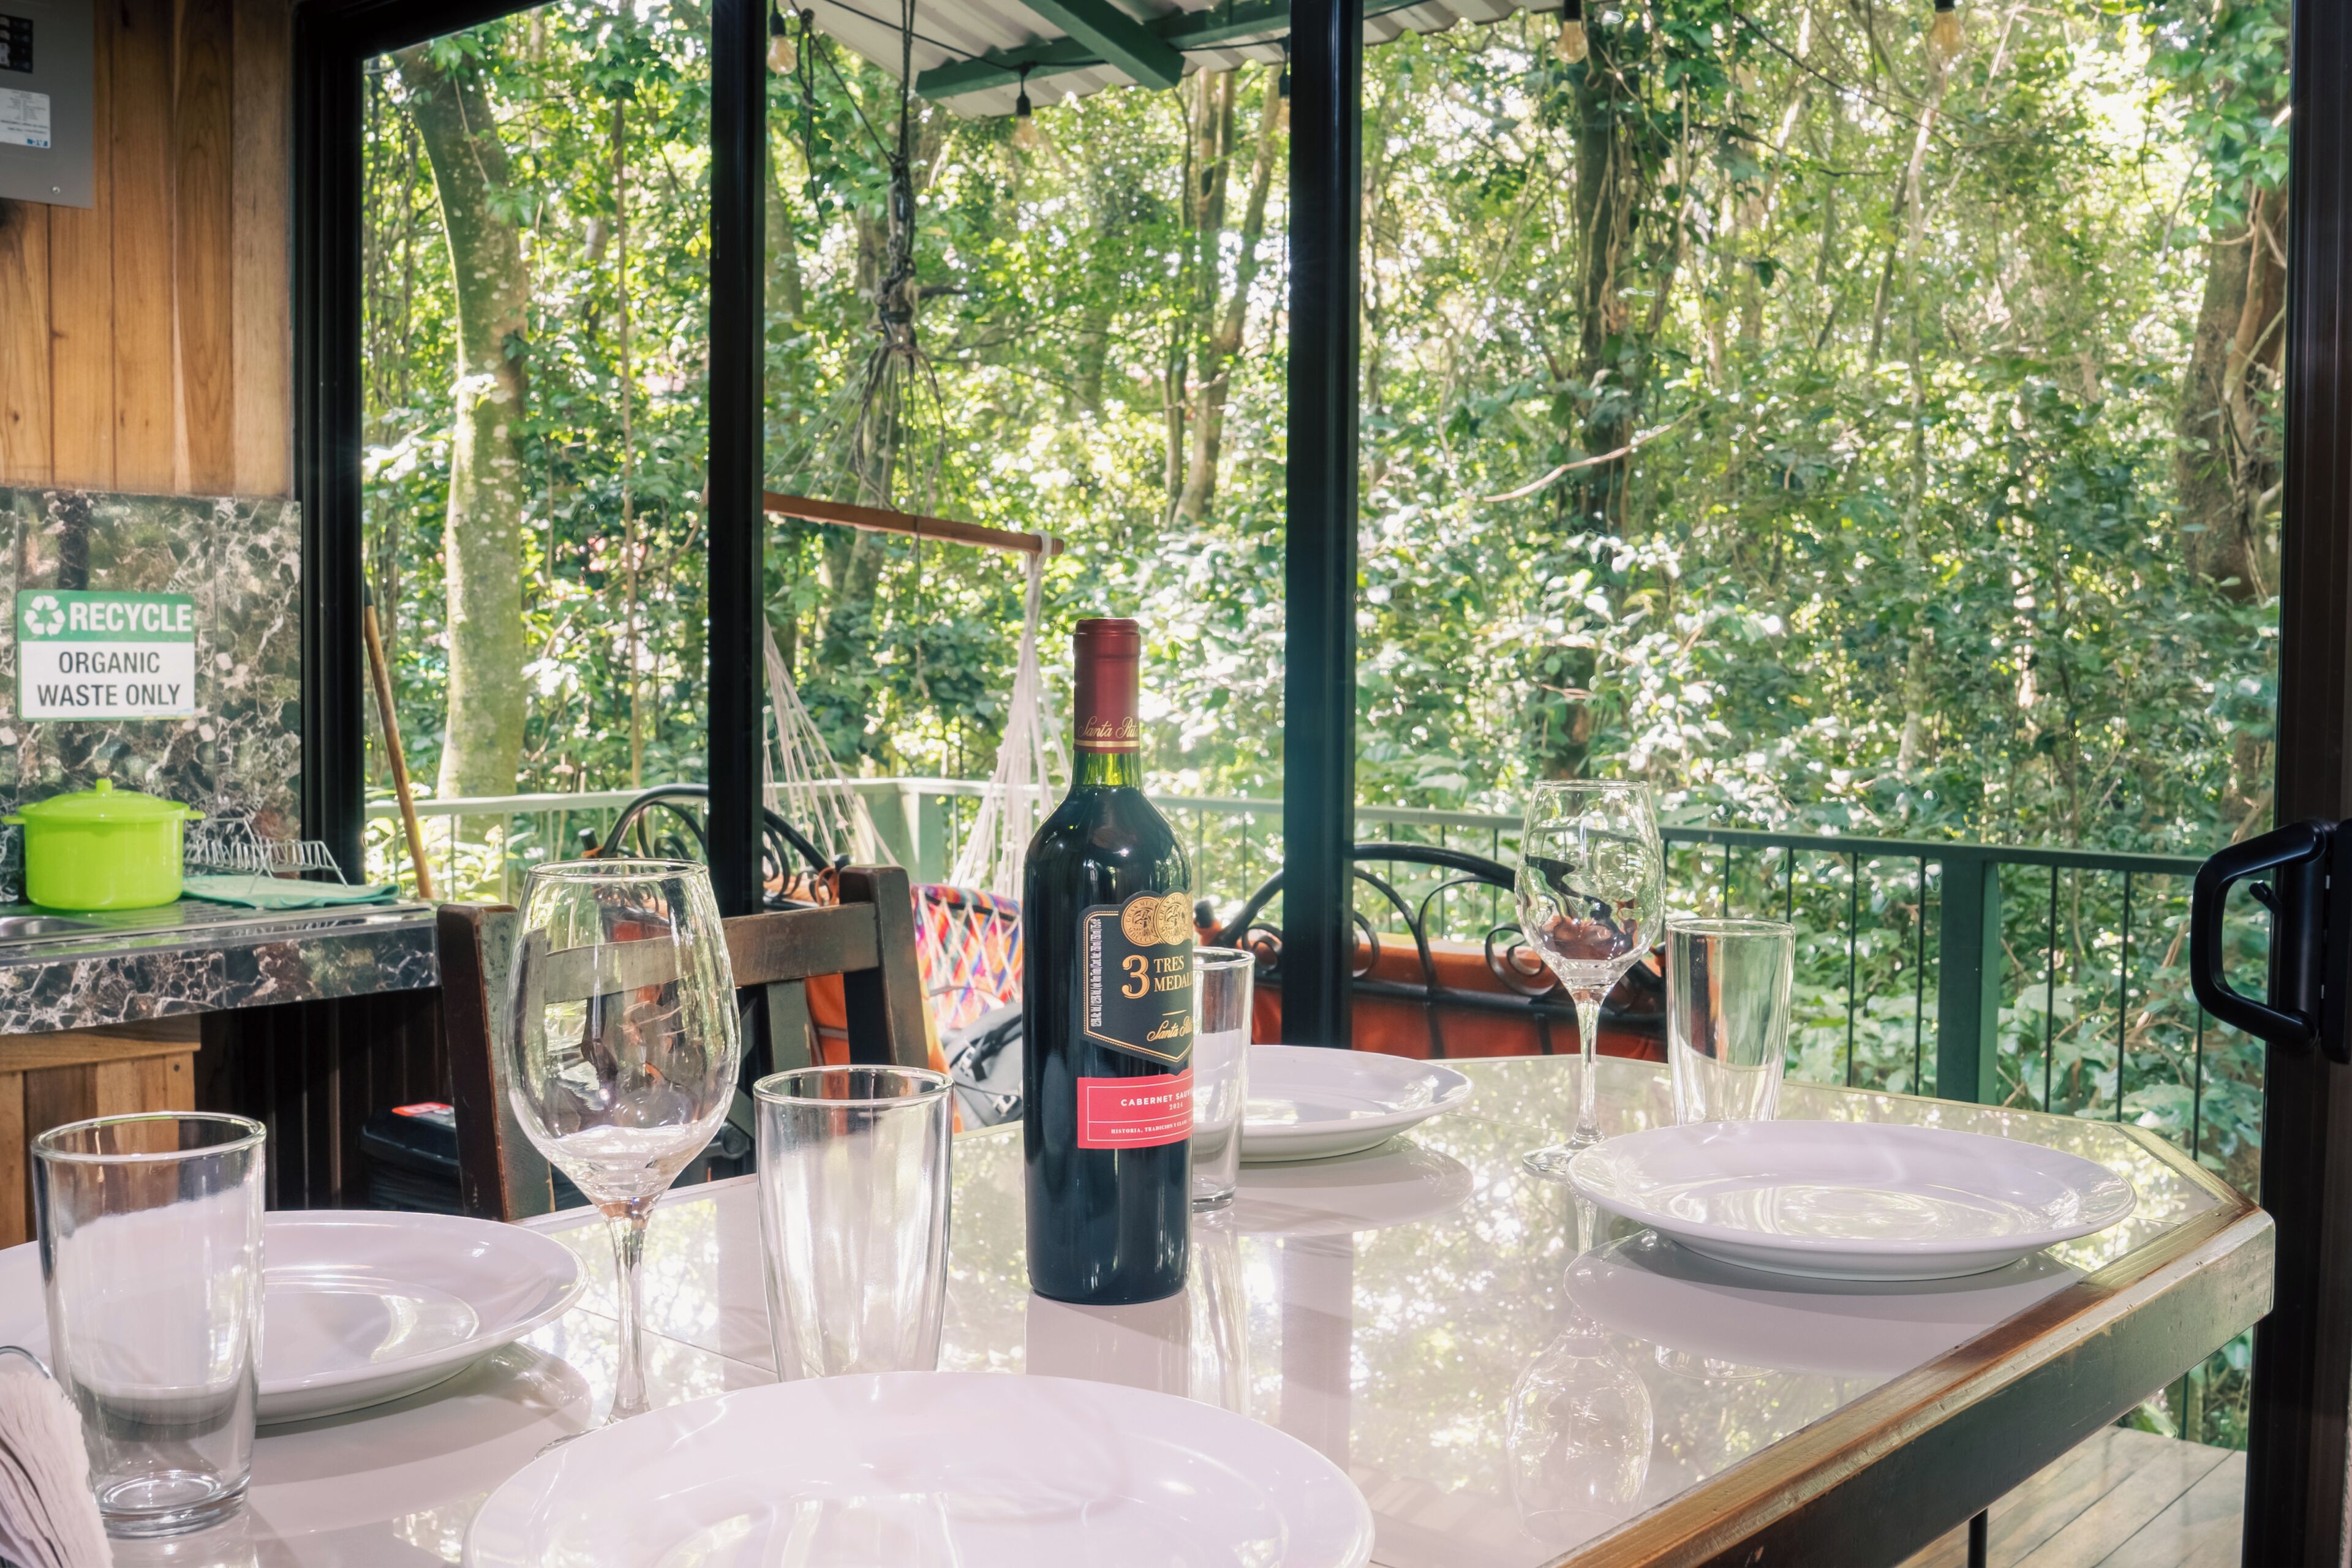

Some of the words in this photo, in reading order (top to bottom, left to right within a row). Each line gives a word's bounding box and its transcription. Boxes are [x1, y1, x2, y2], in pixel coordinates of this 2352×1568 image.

[70, 602, 192, 631] RECYCLE
[59, 652, 160, 673] ORGANIC
[37, 685, 117, 706] WASTE
[126, 684, 180, 705] ONLY
[1078, 715, 1113, 737] Santa
[1122, 955, 1150, 999] 3
[1153, 956, 1185, 973] TRES
[1147, 1020, 1178, 1041] Santa
[1120, 1094, 1173, 1106] CABERNET
[1144, 1123, 1173, 1132] TRADICION
